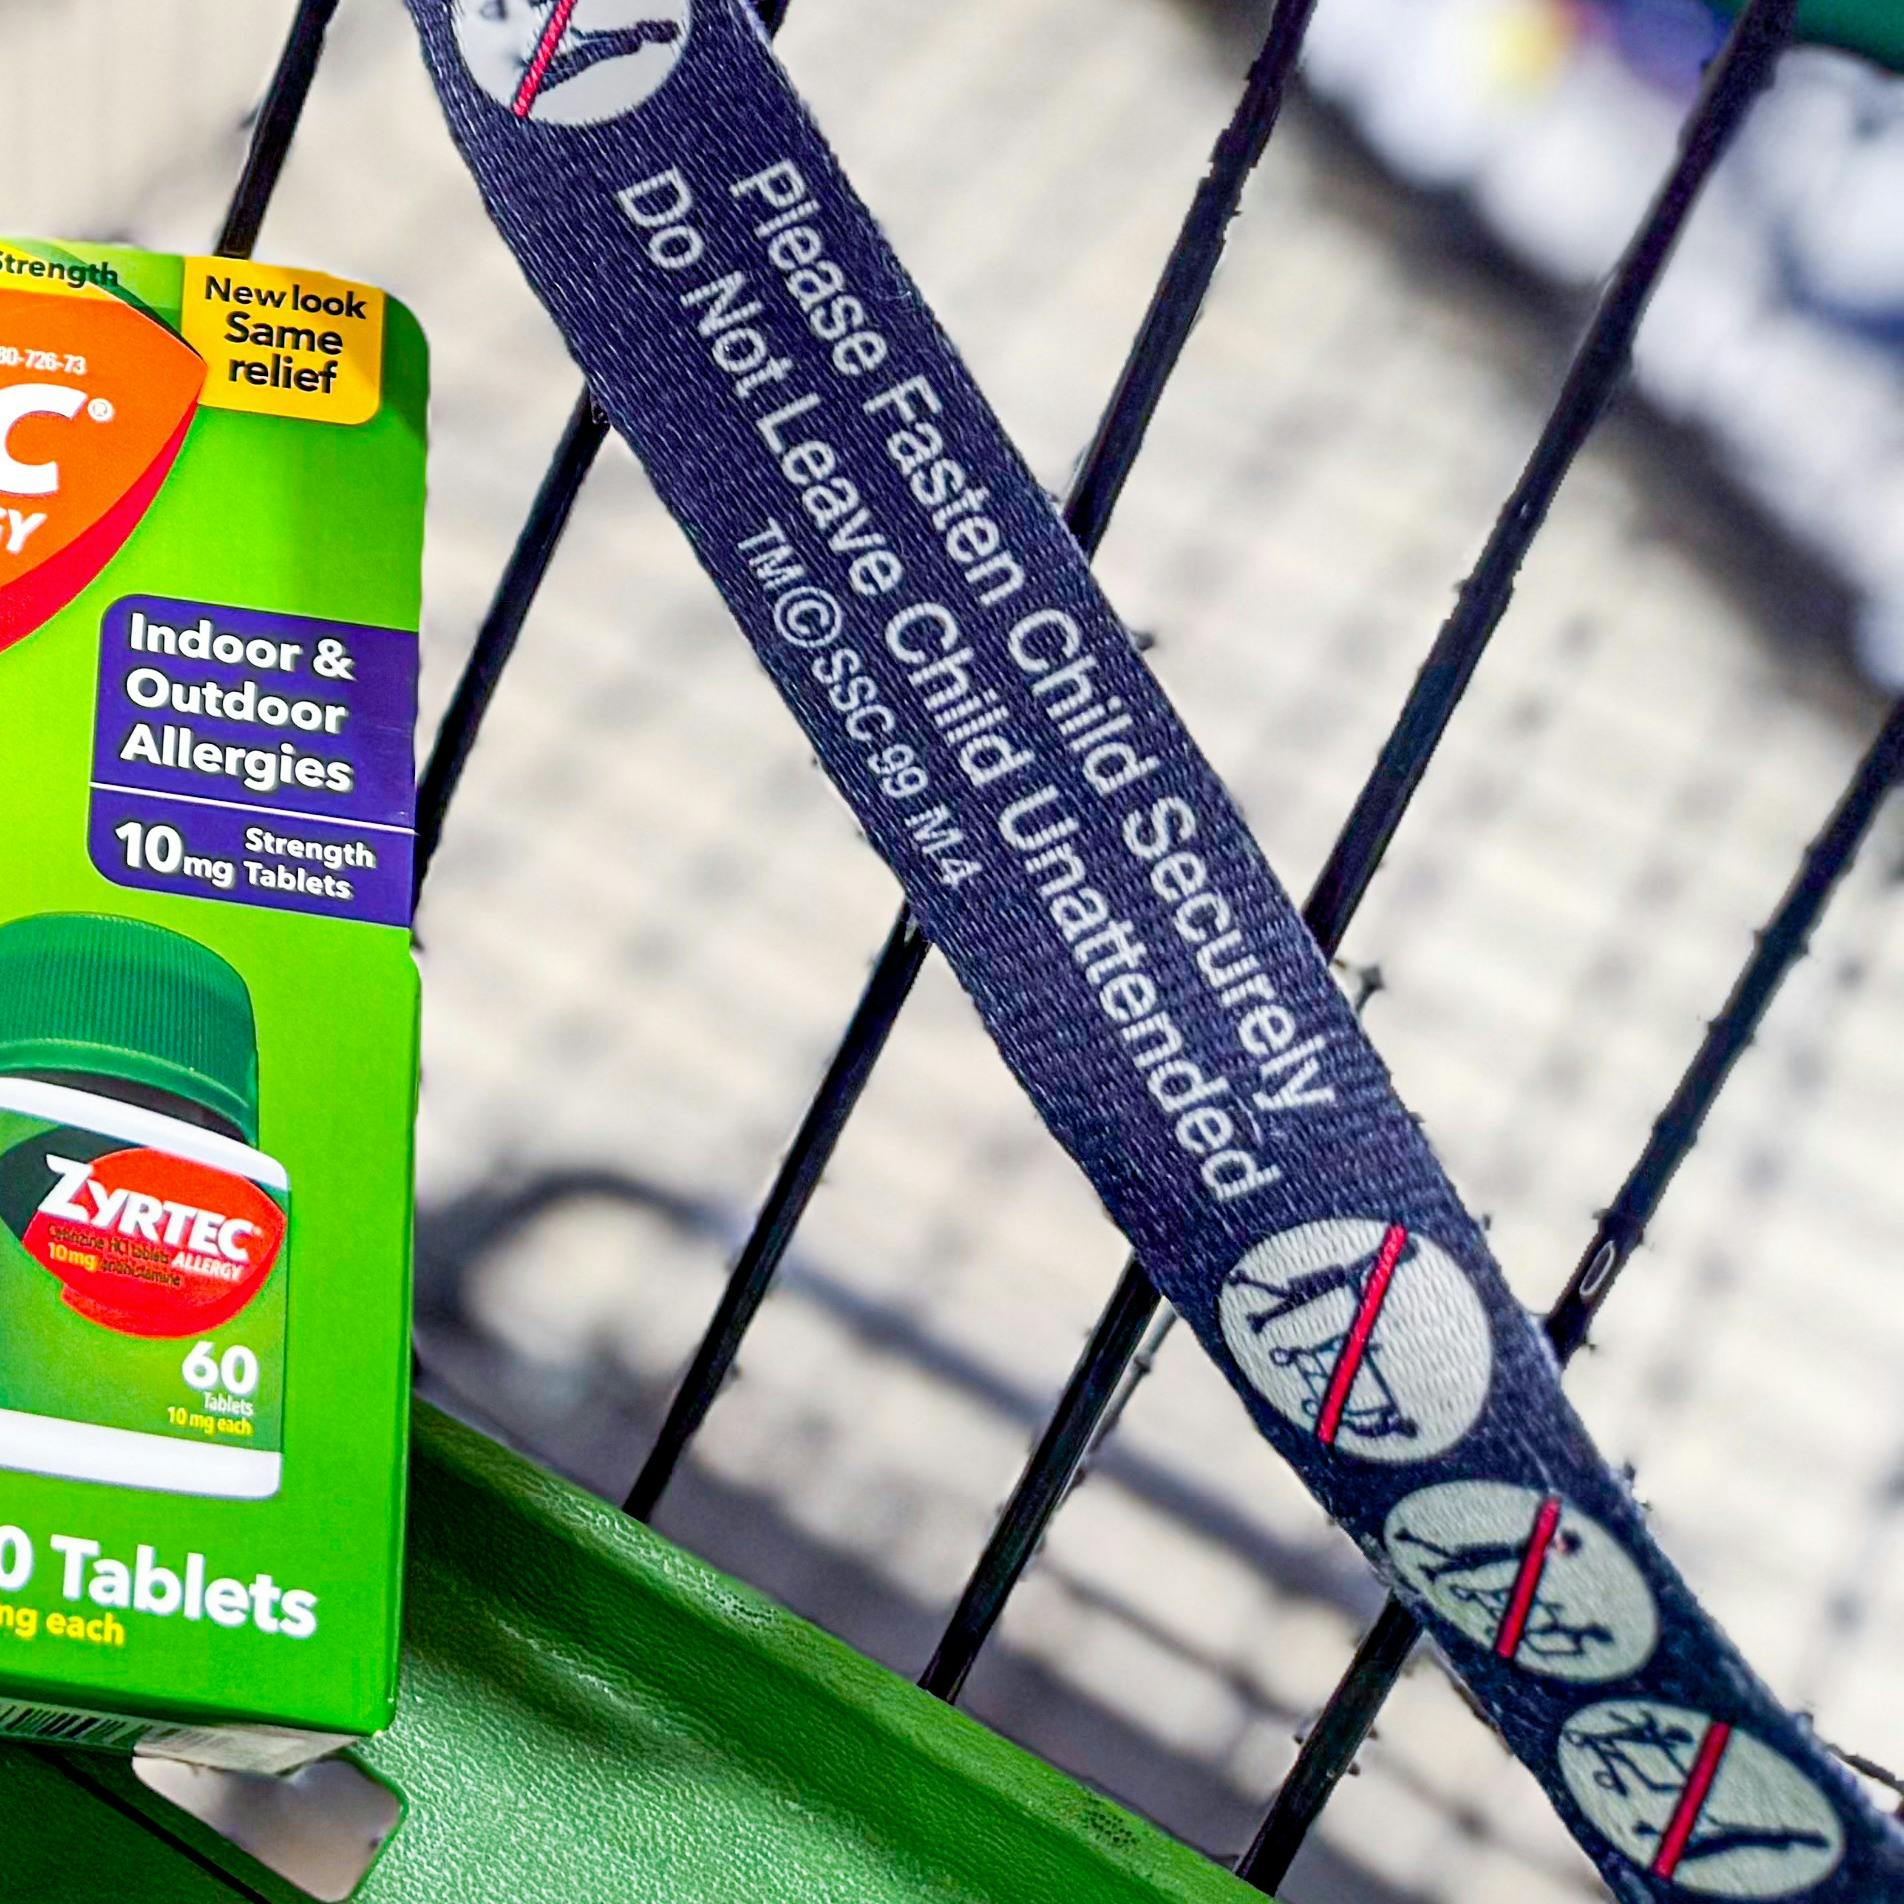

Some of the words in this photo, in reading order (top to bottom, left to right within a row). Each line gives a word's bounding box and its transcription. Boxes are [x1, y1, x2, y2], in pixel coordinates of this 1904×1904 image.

[204, 275, 285, 309] New
[291, 284, 368, 321] look
[224, 311, 345, 357] Same
[227, 356, 338, 394] relief
[128, 612, 303, 673] Indoor
[312, 640, 356, 681] &
[731, 157, 888, 377] Please
[863, 375, 1026, 607] Fasten
[1007, 608, 1161, 797] Child
[1122, 795, 1338, 1113] Securely
[124, 667, 349, 734] Outdoor
[617, 167, 706, 272] Do
[681, 269, 792, 399] Not
[759, 392, 905, 598] Leave
[885, 600, 1036, 790] Child
[998, 782, 1281, 1202] Unattended
[120, 723, 355, 794] Allergies
[245, 826, 378, 871] Strength
[244, 860, 353, 900] Tablets
[37, 1153, 255, 1261] ZYRTEC
[171, 1251, 245, 1282] ALLERGY
[181, 1340, 260, 1396] 60
[166, 1405, 187, 1426] 10
[188, 1411, 216, 1436] mg
[217, 1415, 254, 1437] each
[202, 1391, 255, 1417] Tablets
[49, 1532, 320, 1639] Tablets
[45, 1610, 127, 1646] each
